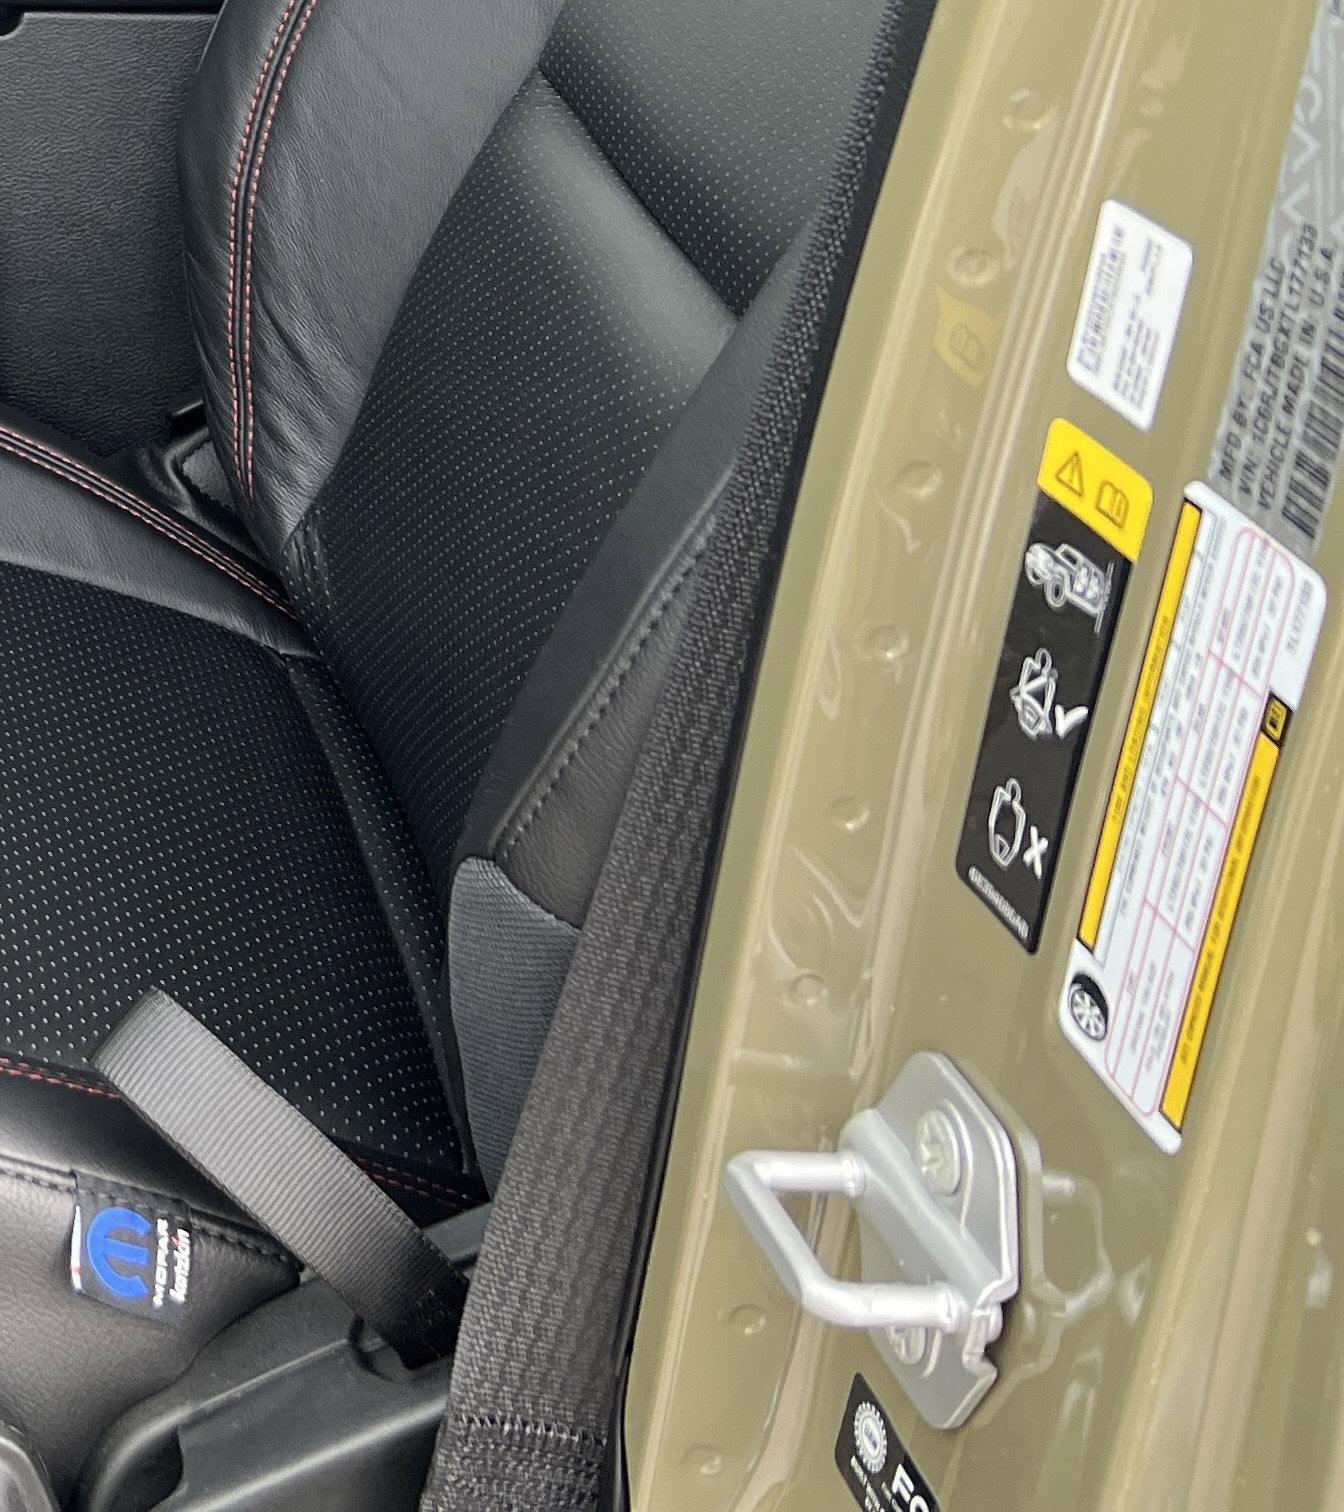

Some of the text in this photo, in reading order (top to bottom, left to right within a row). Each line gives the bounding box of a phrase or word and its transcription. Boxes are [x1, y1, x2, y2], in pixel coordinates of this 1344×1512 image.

[1261, 252, 1286, 302] LLC
[1254, 300, 1274, 336] US
[1241, 334, 1265, 385] FCA
[1256, 417, 1294, 513] VEHICLE
[1280, 348, 1310, 417] MADE
[151, 1217, 169, 1308] MOPAR
